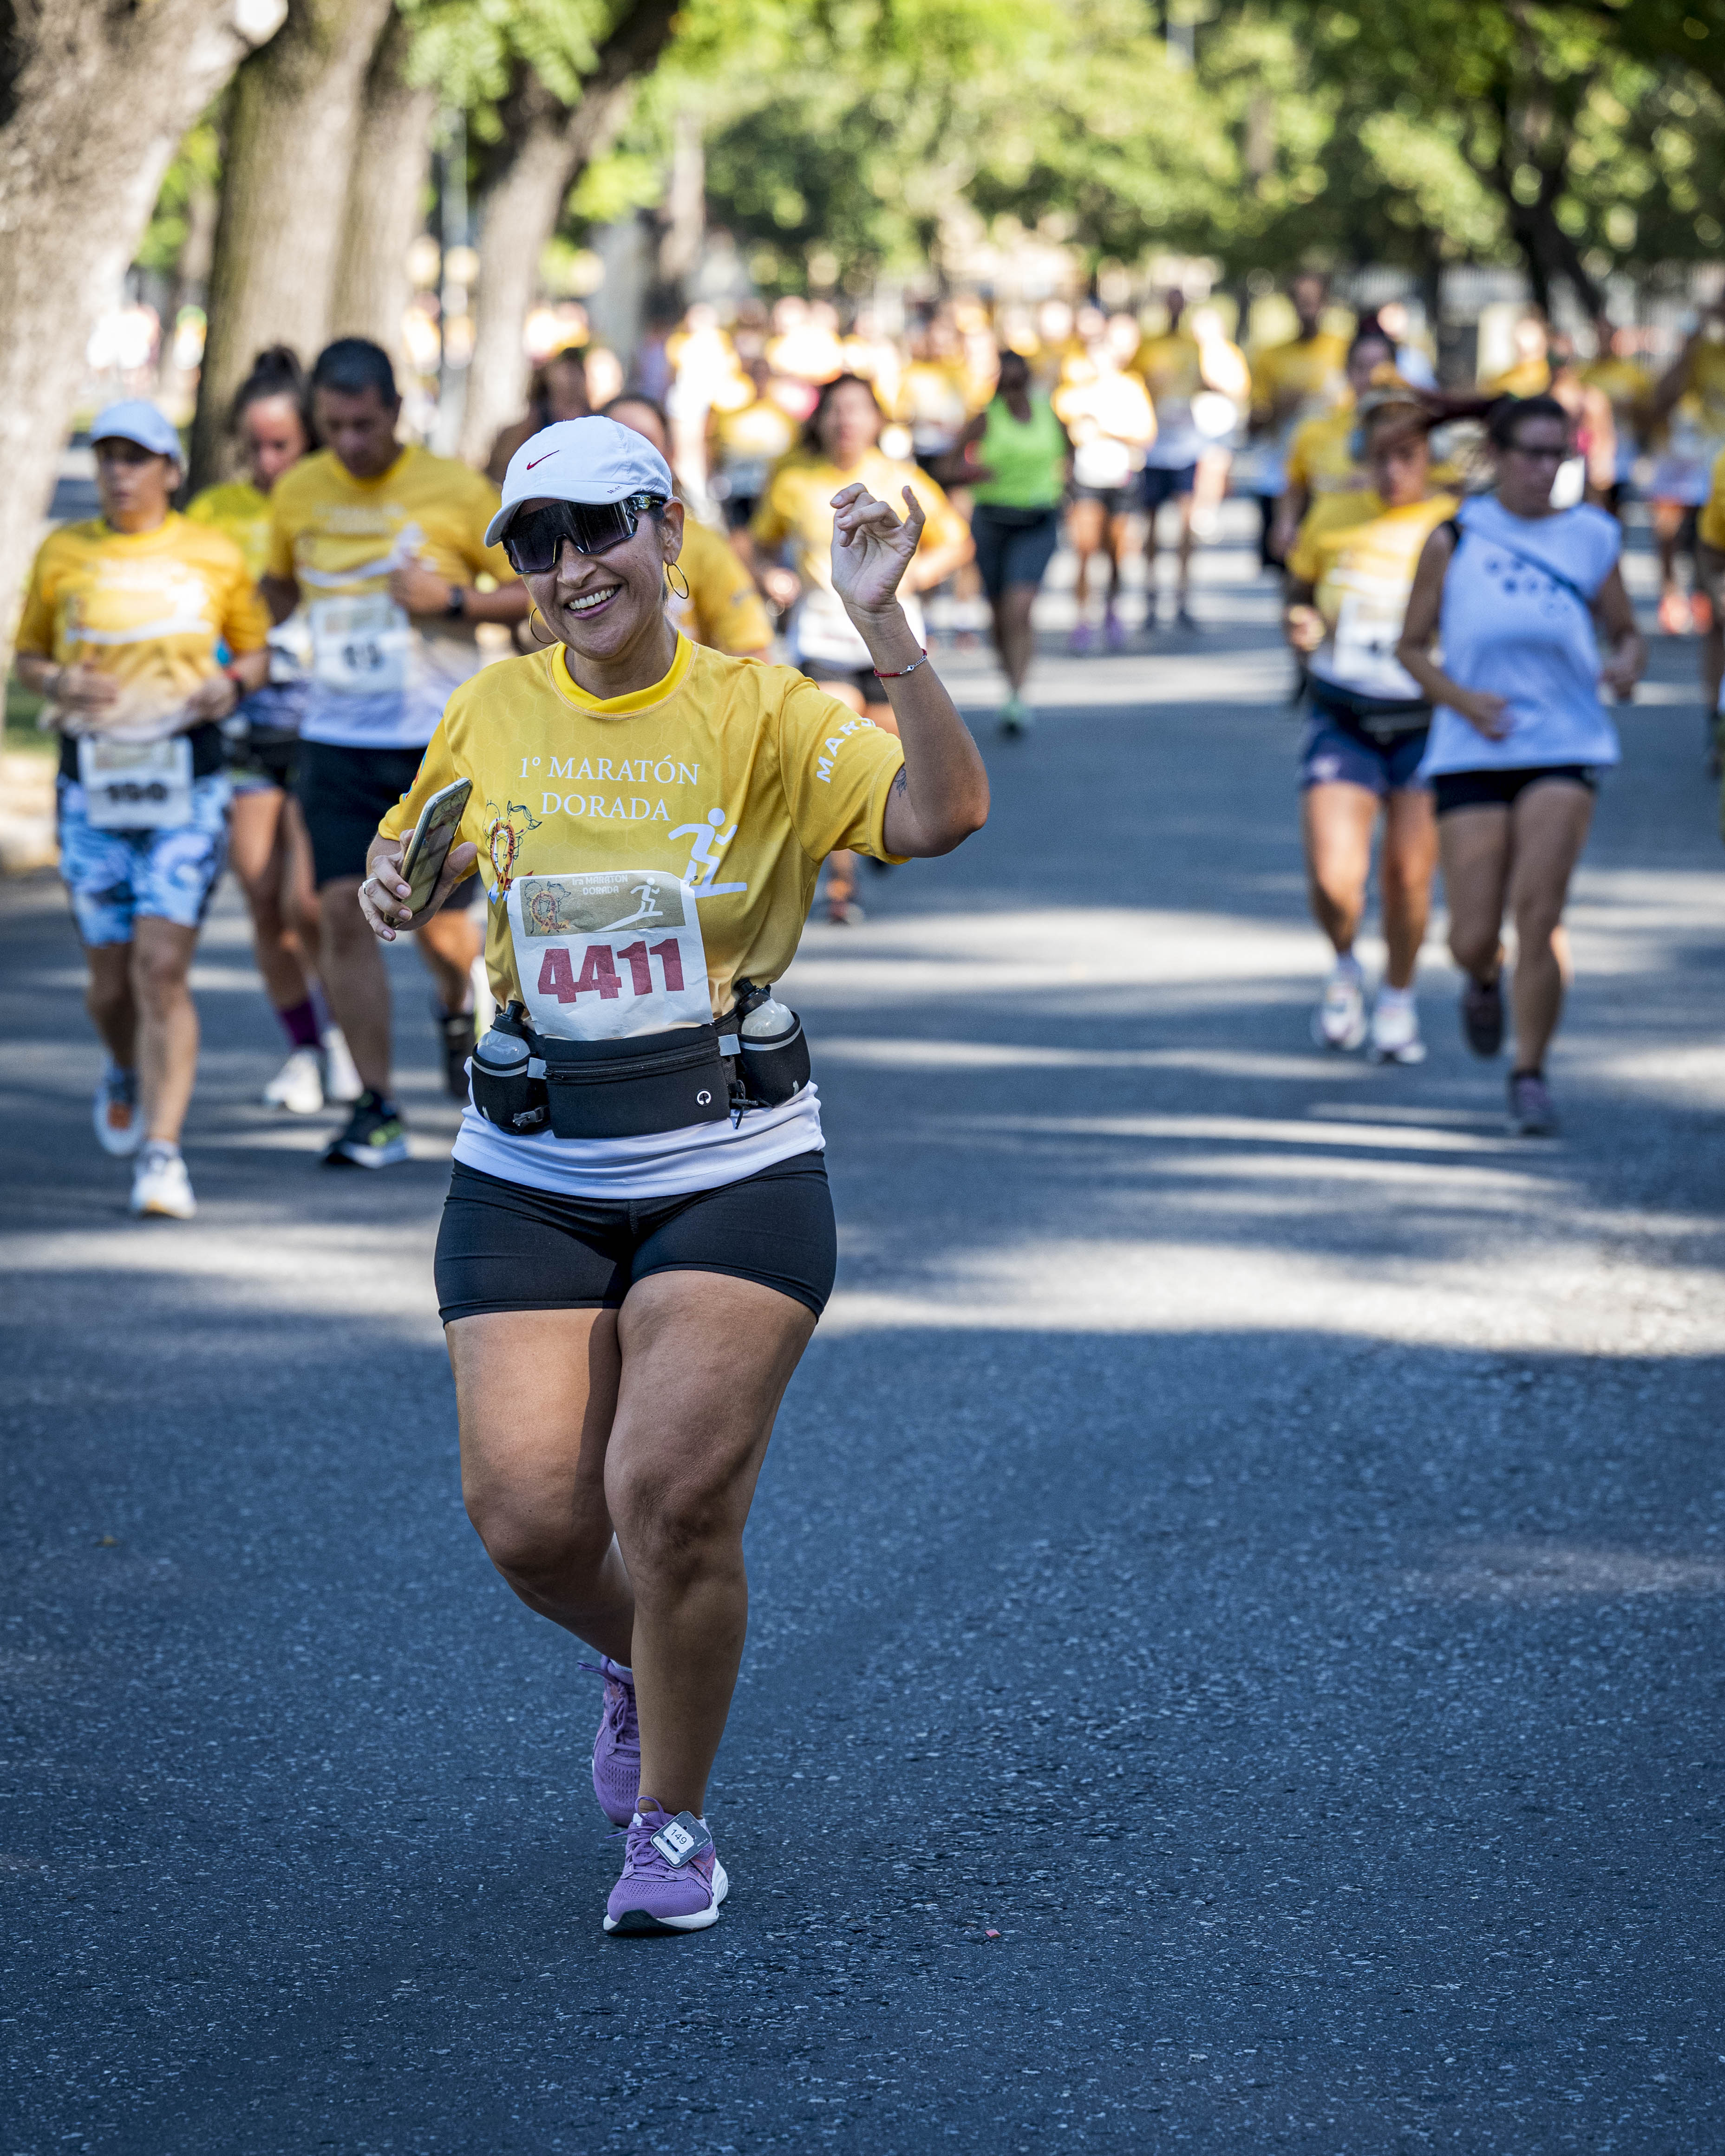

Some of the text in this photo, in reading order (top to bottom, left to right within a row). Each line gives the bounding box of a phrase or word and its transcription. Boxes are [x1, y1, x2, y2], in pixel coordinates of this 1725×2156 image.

[547, 755, 700, 785] MARATÓN
[540, 792, 671, 821] DORADA
[582, 886, 619, 895] DORADA
[537, 938, 685, 1003] 4411
[671, 1829, 687, 1844] 149
